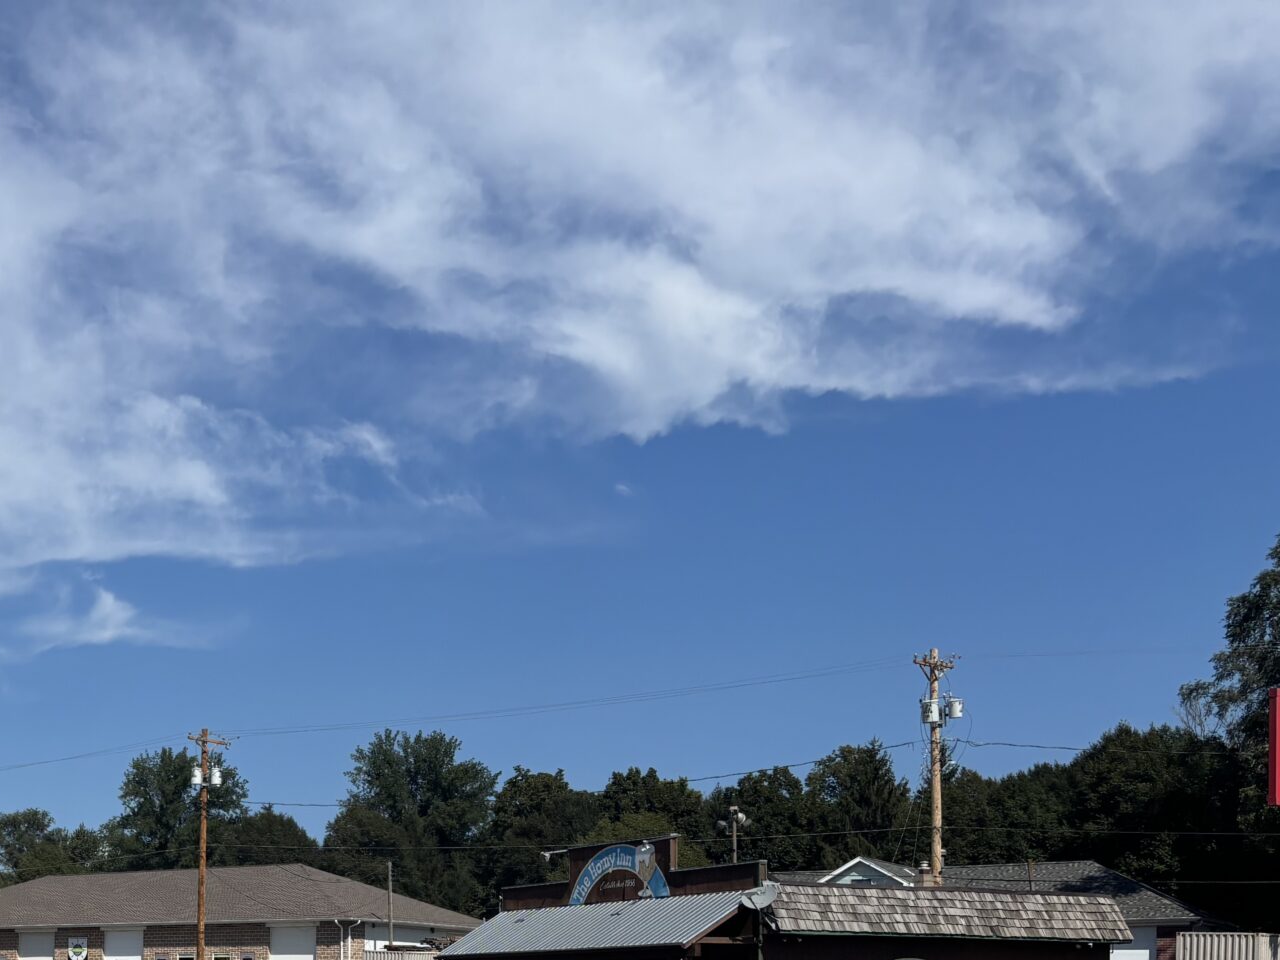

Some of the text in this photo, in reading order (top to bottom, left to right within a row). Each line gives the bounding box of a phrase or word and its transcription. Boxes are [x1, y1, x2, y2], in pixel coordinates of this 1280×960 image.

[572, 848, 632, 901] The Homy Inn
